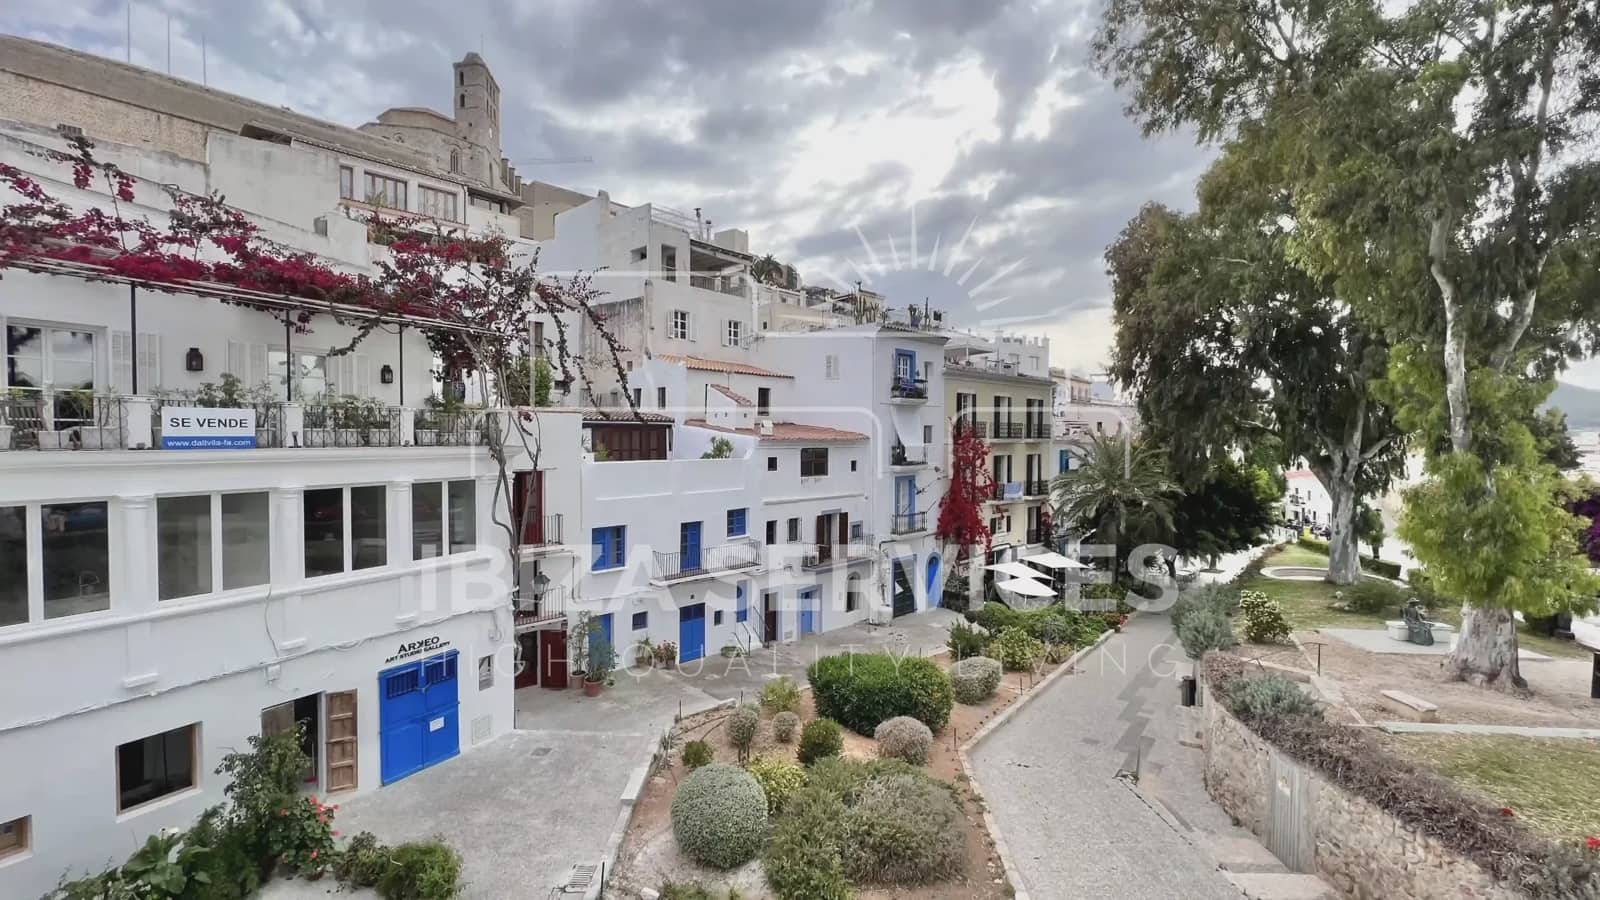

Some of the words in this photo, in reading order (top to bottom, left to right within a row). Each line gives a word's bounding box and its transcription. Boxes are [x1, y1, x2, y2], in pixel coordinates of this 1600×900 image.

[170, 418, 191, 428] SE
[197, 418, 249, 428] VENDE
[400, 649, 422, 659] STUDIO
